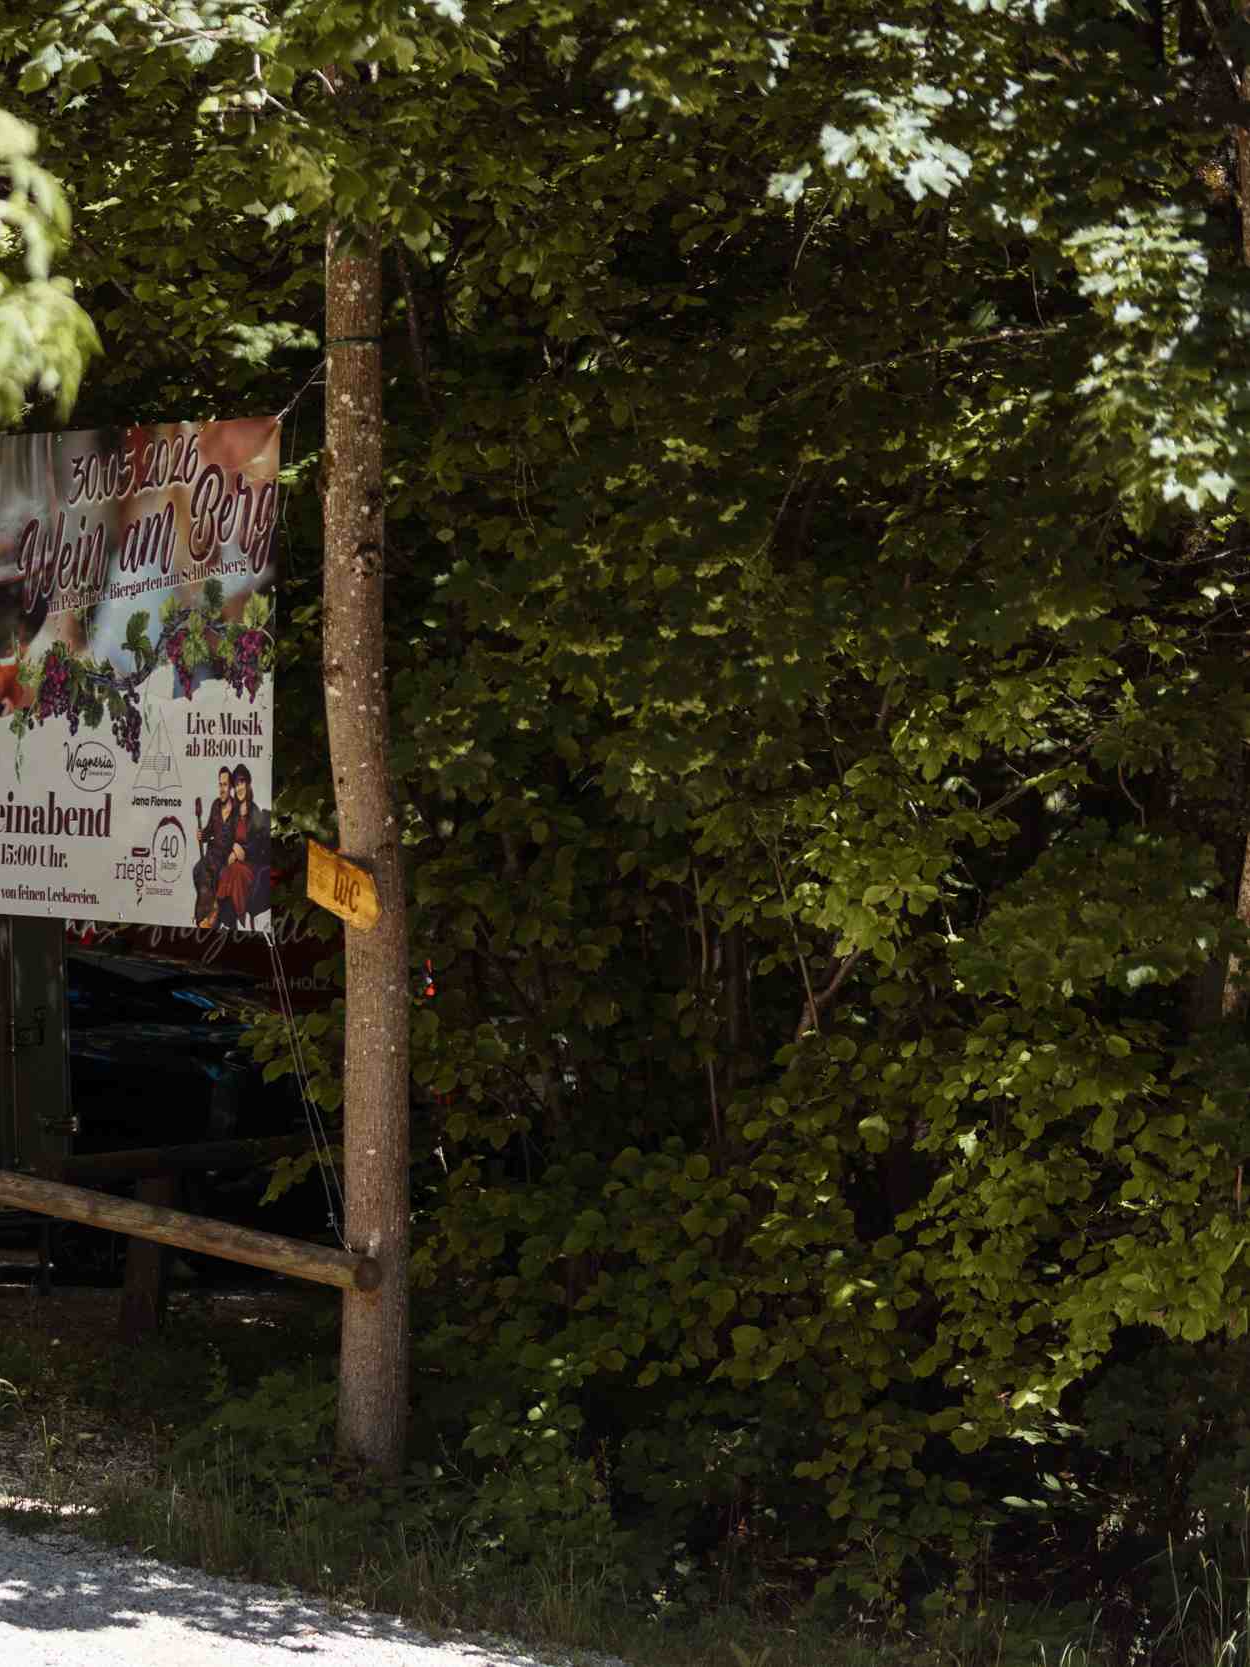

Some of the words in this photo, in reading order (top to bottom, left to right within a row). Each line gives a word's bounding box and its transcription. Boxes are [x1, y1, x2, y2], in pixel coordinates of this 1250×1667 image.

[69, 434, 198, 505] 30.05.2026
[17, 510, 107, 614] Wein
[119, 501, 175, 575] am
[190, 463, 279, 575] Berg
[110, 577, 162, 600] Biergarten
[164, 573, 181, 587] am
[182, 559, 246, 585] Schlossberg
[187, 711, 216, 736] Live
[220, 711, 263, 736] Musik
[186, 737, 200, 758] ab
[202, 738, 237, 759] 18:00
[239, 738, 263, 759] Uhr
[151, 796, 182, 808] Florence
[0, 843, 38, 866] 15:00
[40, 844, 69, 868] Uhr.
[161, 835, 179, 858] 40
[115, 856, 157, 888] riegel
[1, 888, 17, 899] von
[18, 884, 46, 901] feinen
[47, 886, 100, 905] Leckereien.
[334, 869, 360, 913] WC
